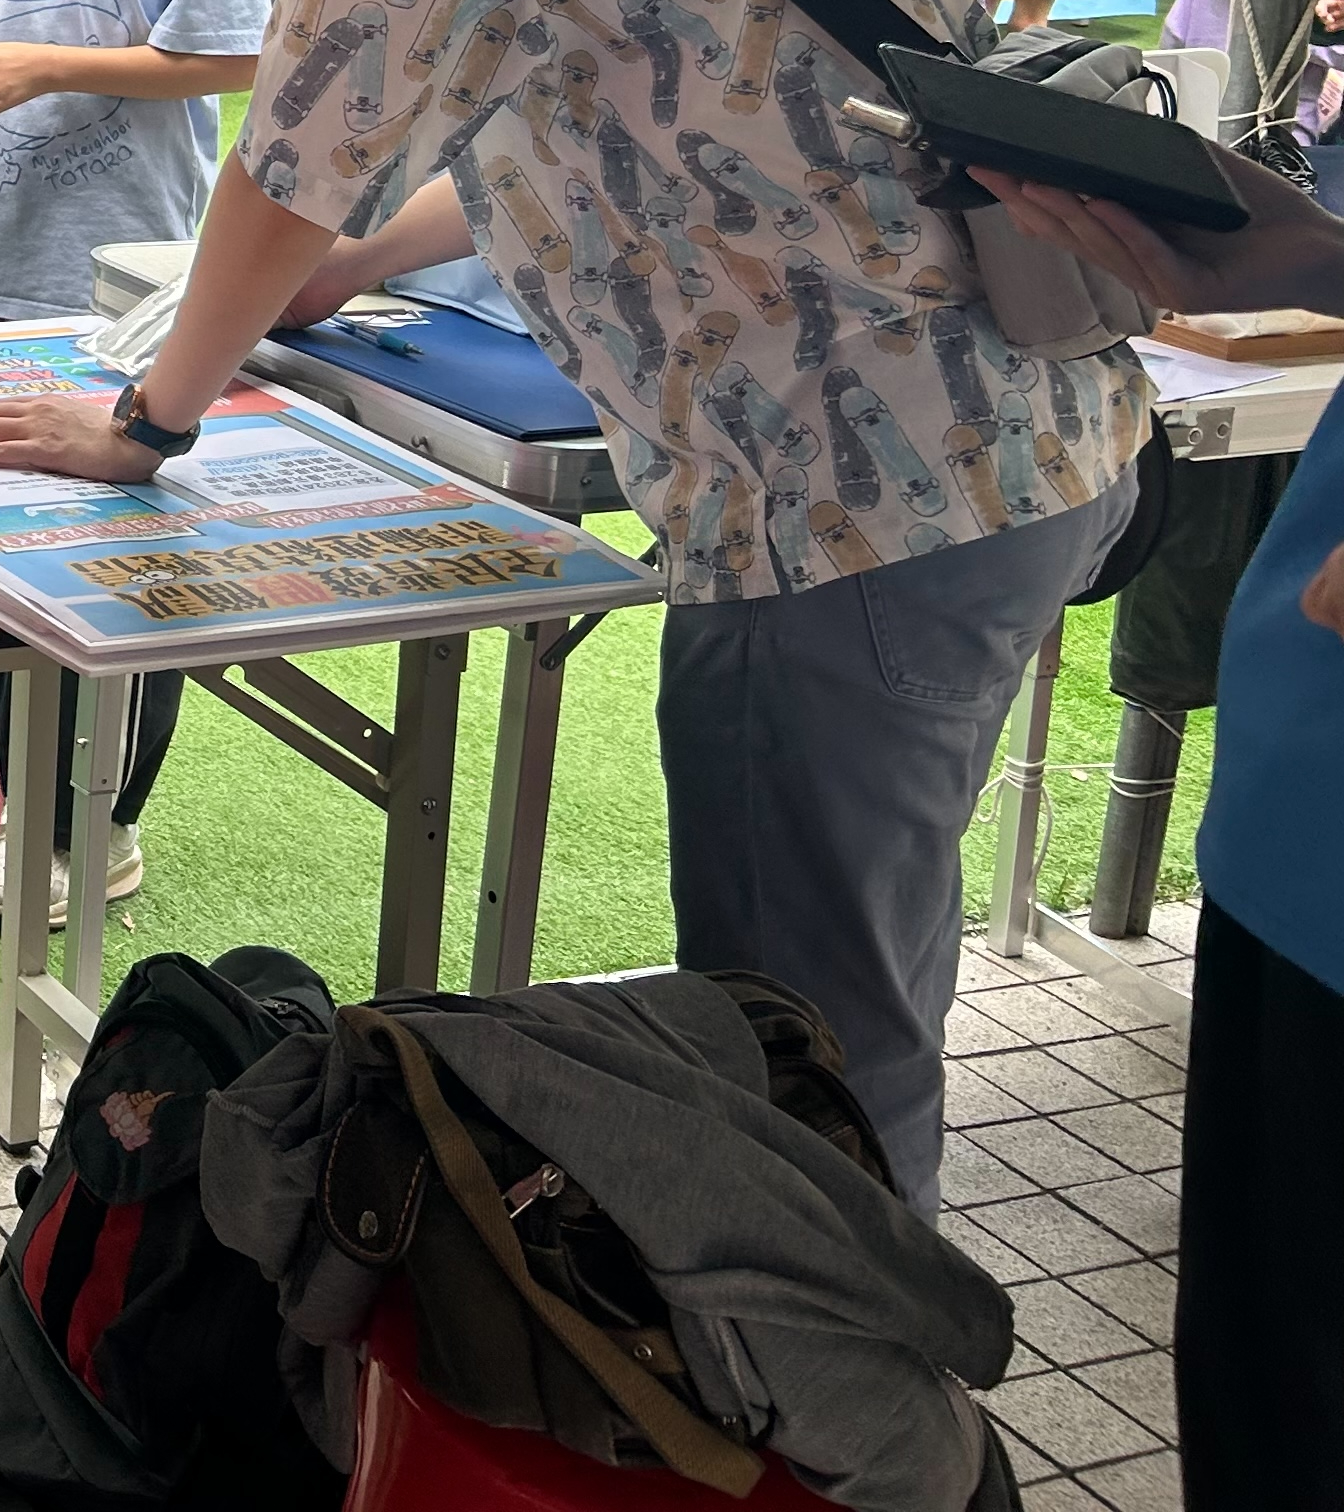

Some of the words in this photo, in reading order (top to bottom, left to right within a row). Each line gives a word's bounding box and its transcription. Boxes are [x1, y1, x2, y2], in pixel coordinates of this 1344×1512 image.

[32, 155, 60, 172] My
[65, 118, 132, 164] Neighbor
[44, 145, 133, 190] TOTORO
[116, 544, 562, 620] 全民普發假簡訊
